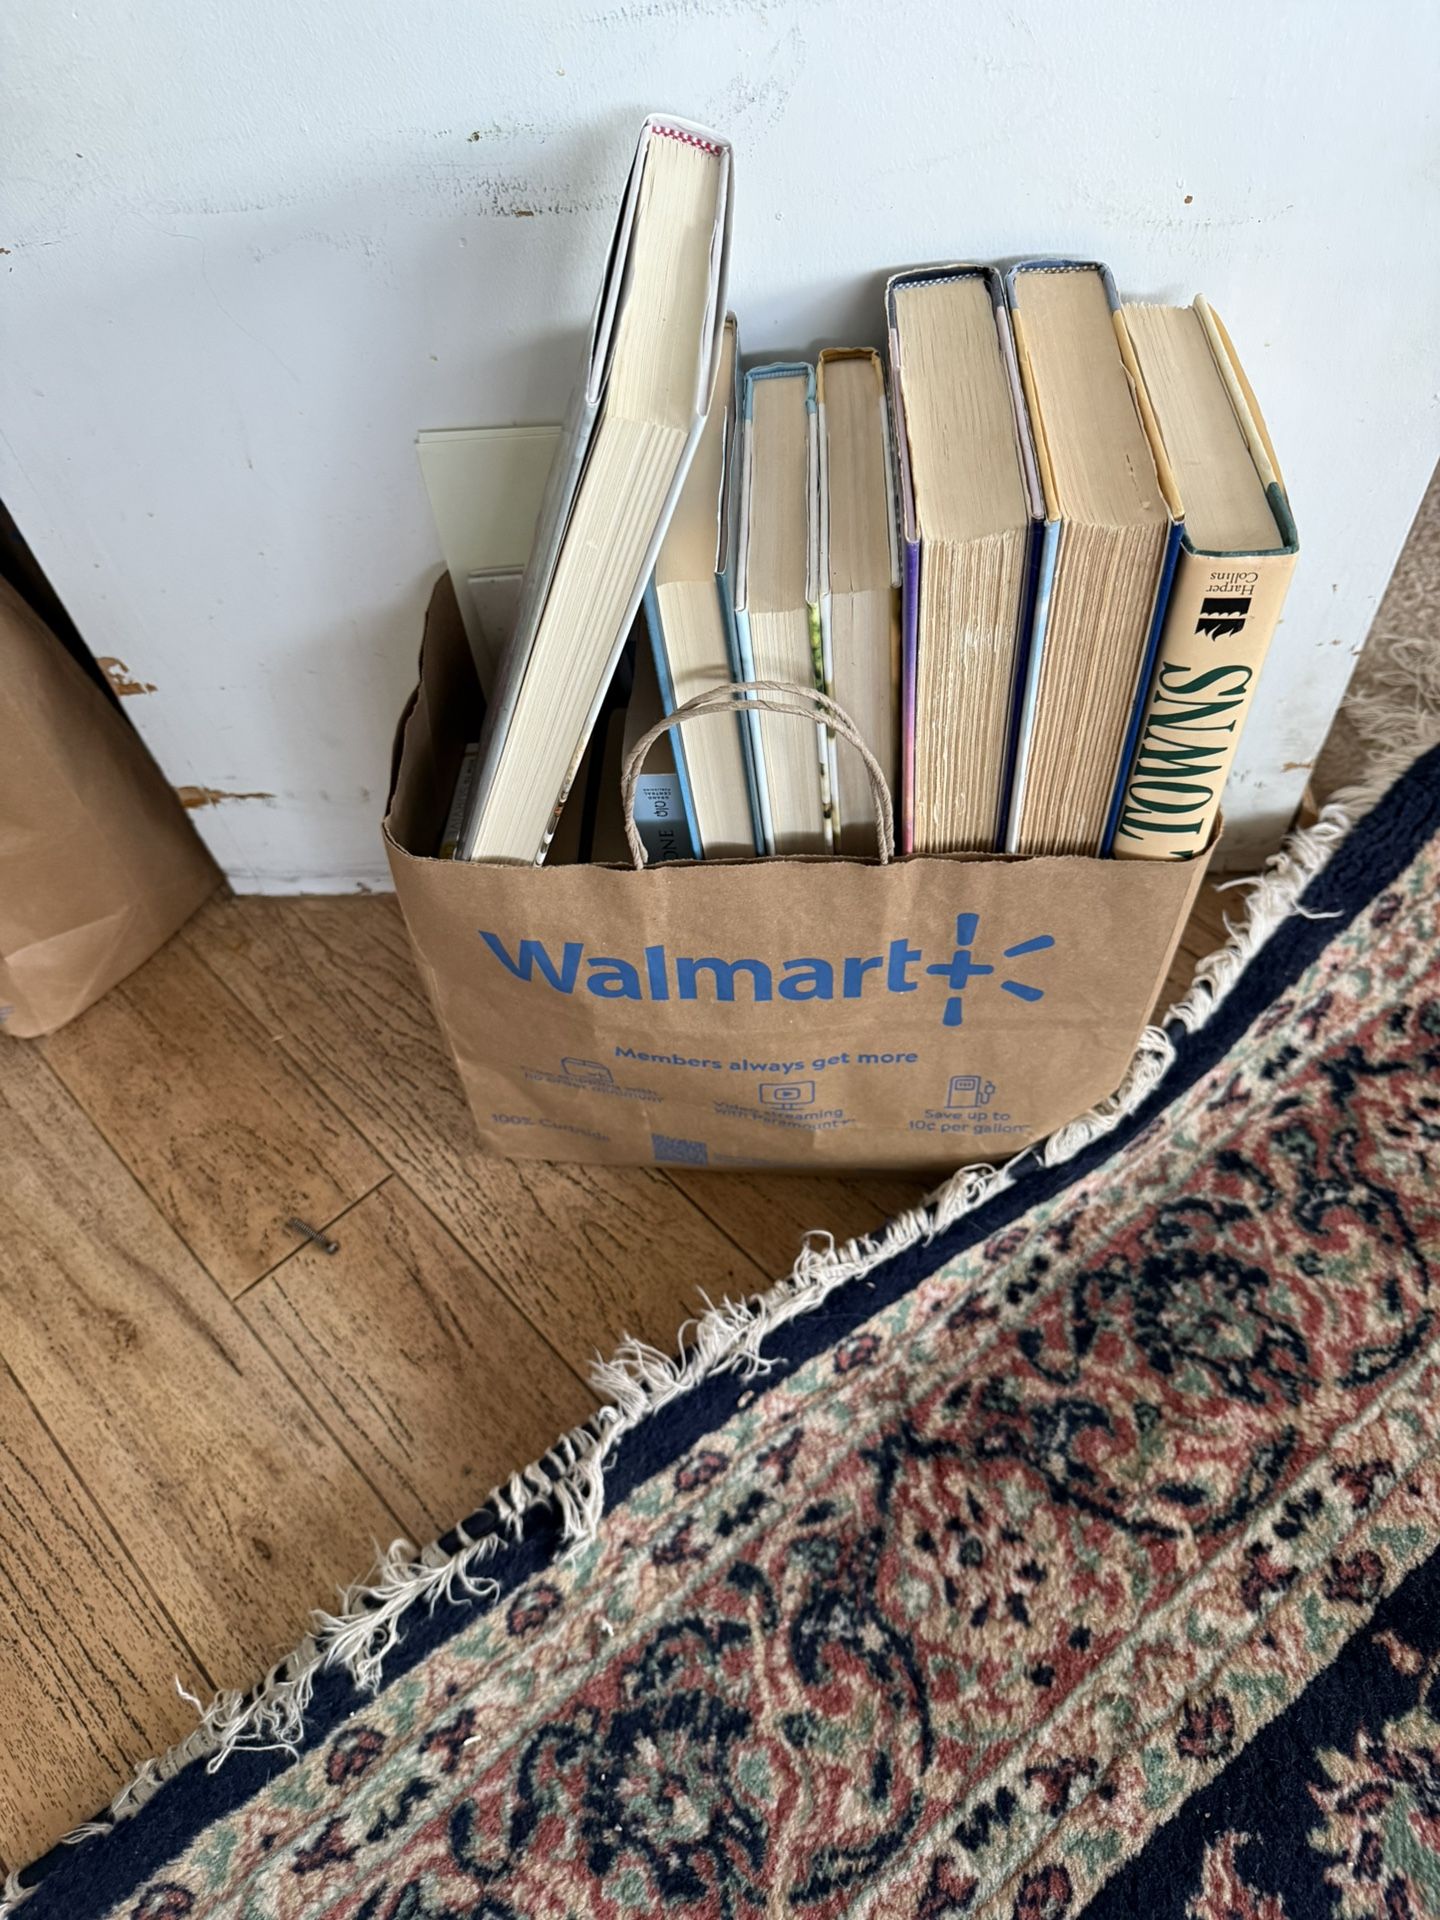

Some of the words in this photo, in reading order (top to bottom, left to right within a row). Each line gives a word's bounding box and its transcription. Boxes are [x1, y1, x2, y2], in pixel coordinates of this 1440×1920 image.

[1209, 571, 1260, 584] Collins
[1205, 581, 1256, 597] Harper
[1118, 661, 1253, 841] TOWNS
[615, 1046, 723, 1070] Members
[729, 1058, 805, 1075] always
[812, 1053, 851, 1071] get
[857, 1051, 918, 1065] more
[924, 1109, 963, 1120] Save
[967, 1111, 988, 1122] up
[992, 1111, 1011, 1121] to
[908, 1119, 936, 1132] 10¢
[940, 1121, 969, 1133] per
